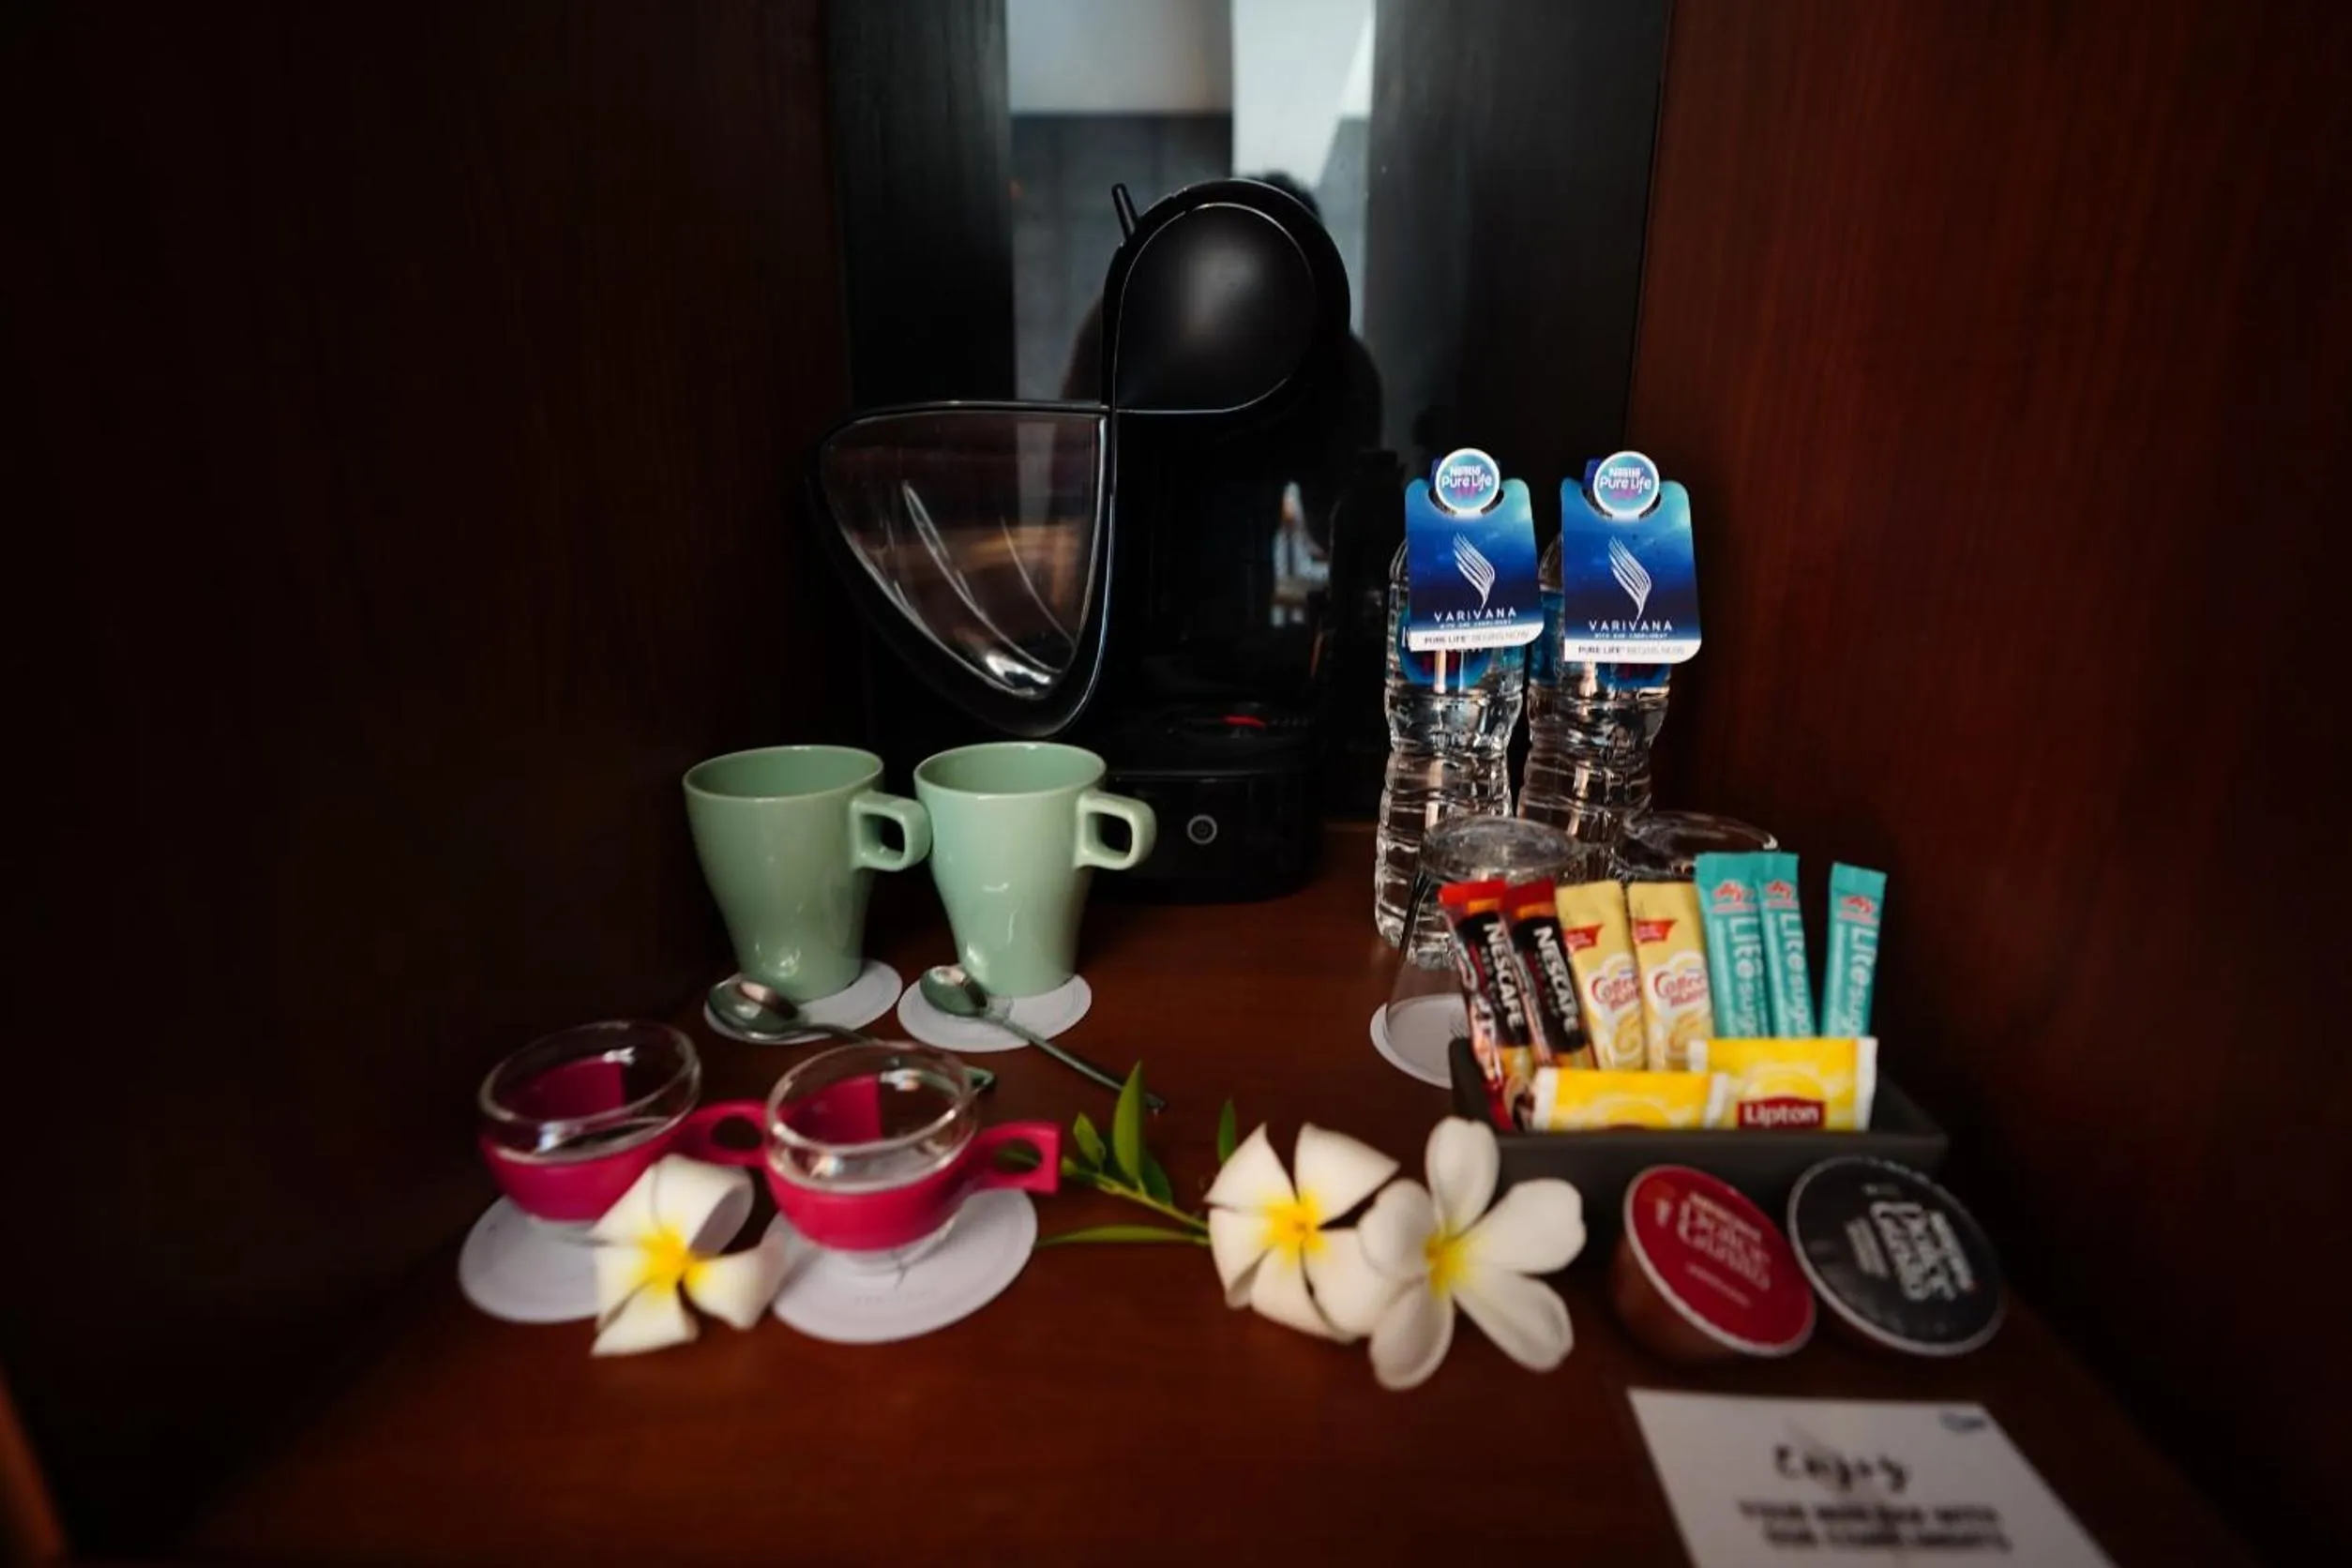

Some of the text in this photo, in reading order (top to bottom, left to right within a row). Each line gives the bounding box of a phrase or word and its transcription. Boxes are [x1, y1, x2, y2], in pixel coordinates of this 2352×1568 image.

[1441, 473, 1492, 491] Pure Life
[1600, 476, 1652, 495] Pure Life
[1434, 607, 1517, 623] VARIVANA
[1589, 620, 1673, 631] VARIVANA
[1424, 636, 1445, 644] PURE
[1744, 1105, 1818, 1125] Lipton
